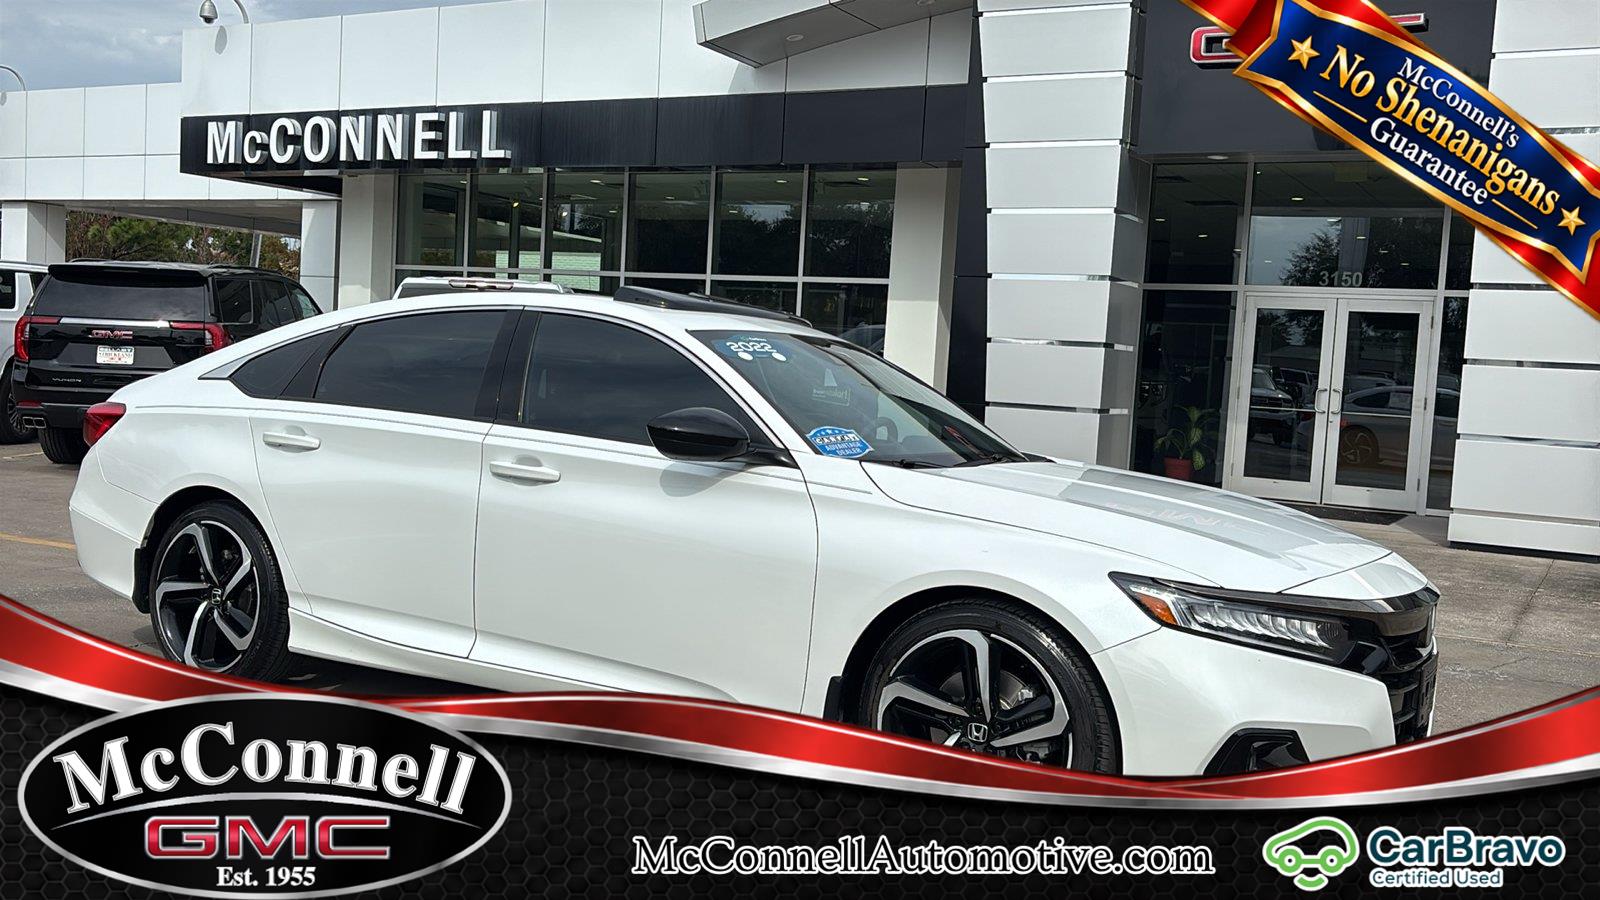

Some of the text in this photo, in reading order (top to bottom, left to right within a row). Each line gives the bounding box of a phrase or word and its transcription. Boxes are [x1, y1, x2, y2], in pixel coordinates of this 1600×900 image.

[206, 109, 512, 165] McCONNELL
[1319, 271, 1363, 288] 3150
[91, 329, 133, 339] GMC
[726, 341, 777, 352] 2022
